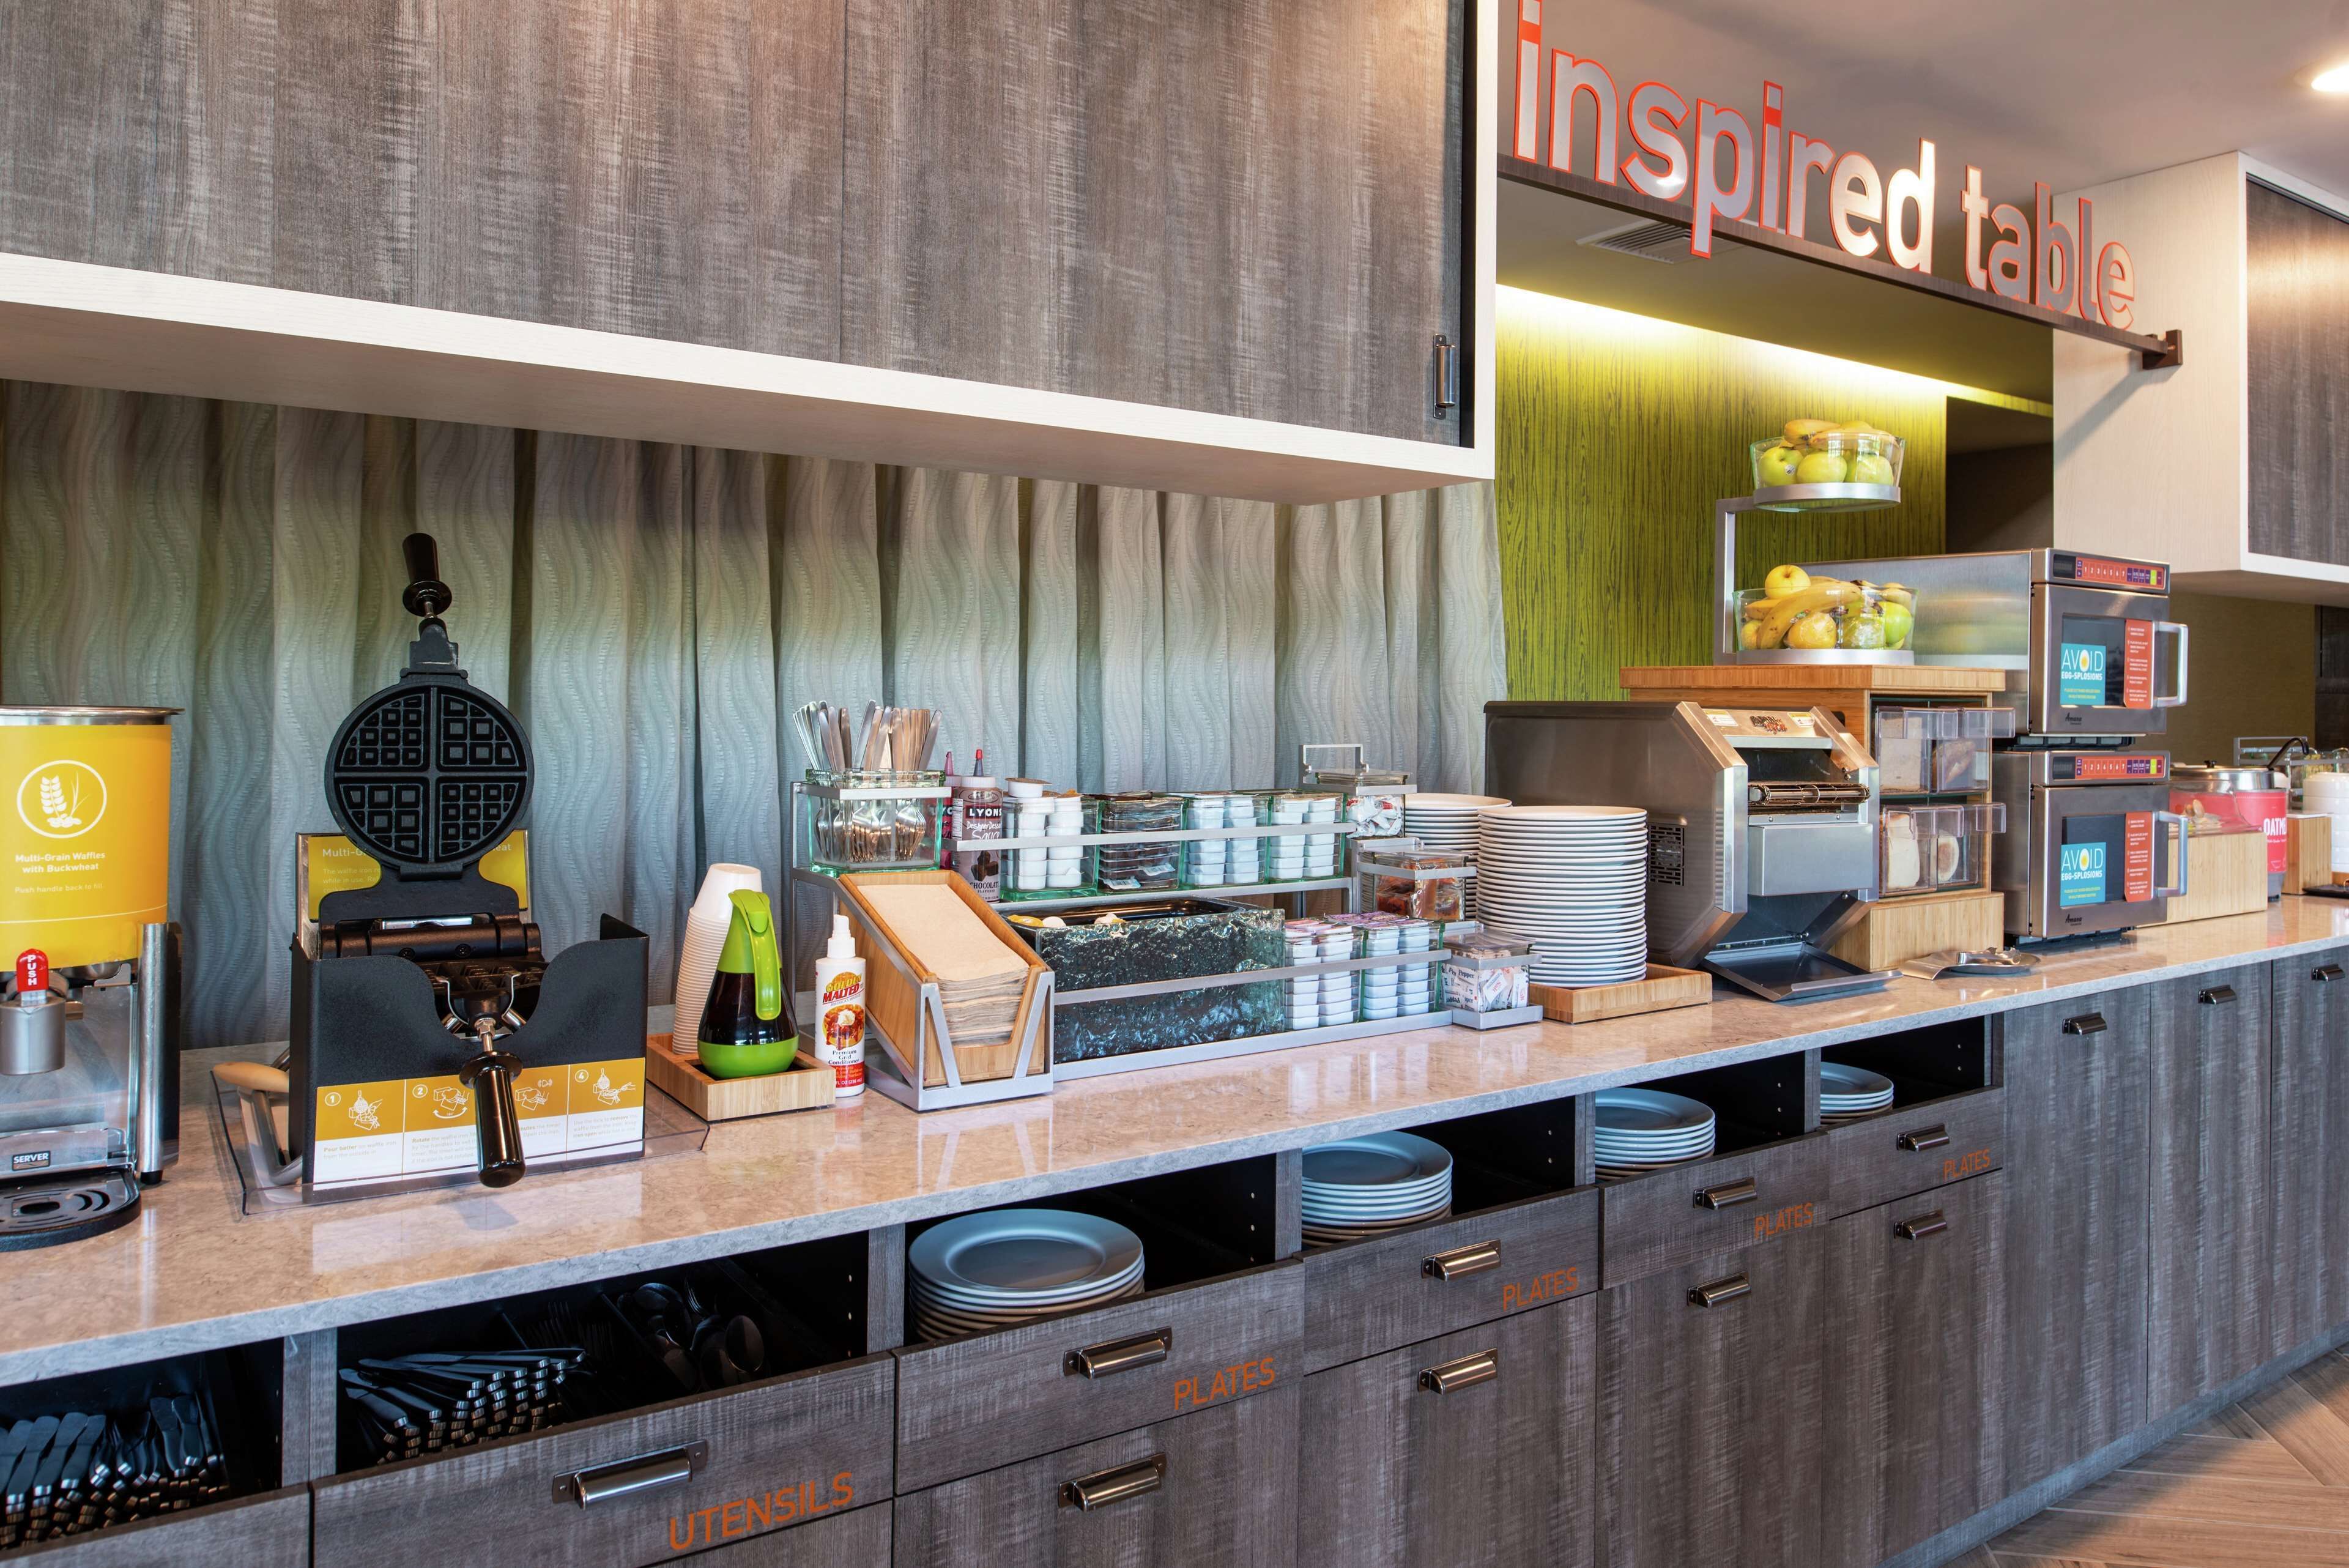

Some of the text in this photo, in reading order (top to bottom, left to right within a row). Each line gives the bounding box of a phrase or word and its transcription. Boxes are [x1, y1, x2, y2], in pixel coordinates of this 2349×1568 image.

[1514, 0, 2136, 331] inspired table
[2061, 649, 2104, 672] AVOID
[2061, 671, 2102, 681] EGG-SPLOSIONS
[969, 808, 1002, 817] LYONS
[15, 851, 105, 863] Multi-Grain Waffles
[2061, 848, 2103, 871] AVOID
[22, 863, 98, 874] with Buckwheat
[2061, 871, 2102, 881] EGG-SPLOSIONS
[27, 954, 37, 986] PUSH
[1458, 969, 1475, 978] Pepper
[823, 983, 859, 1003] MALTED
[578, 1071, 585, 1080] 4
[13, 1153, 49, 1164] SERVER
[1943, 1150, 1989, 1177] PLATES
[1754, 1203, 1813, 1237] PLATES
[1502, 1267, 1578, 1310] PLATES
[1174, 1357, 1275, 1410] PLATES
[669, 1472, 854, 1550] UTENSILS
